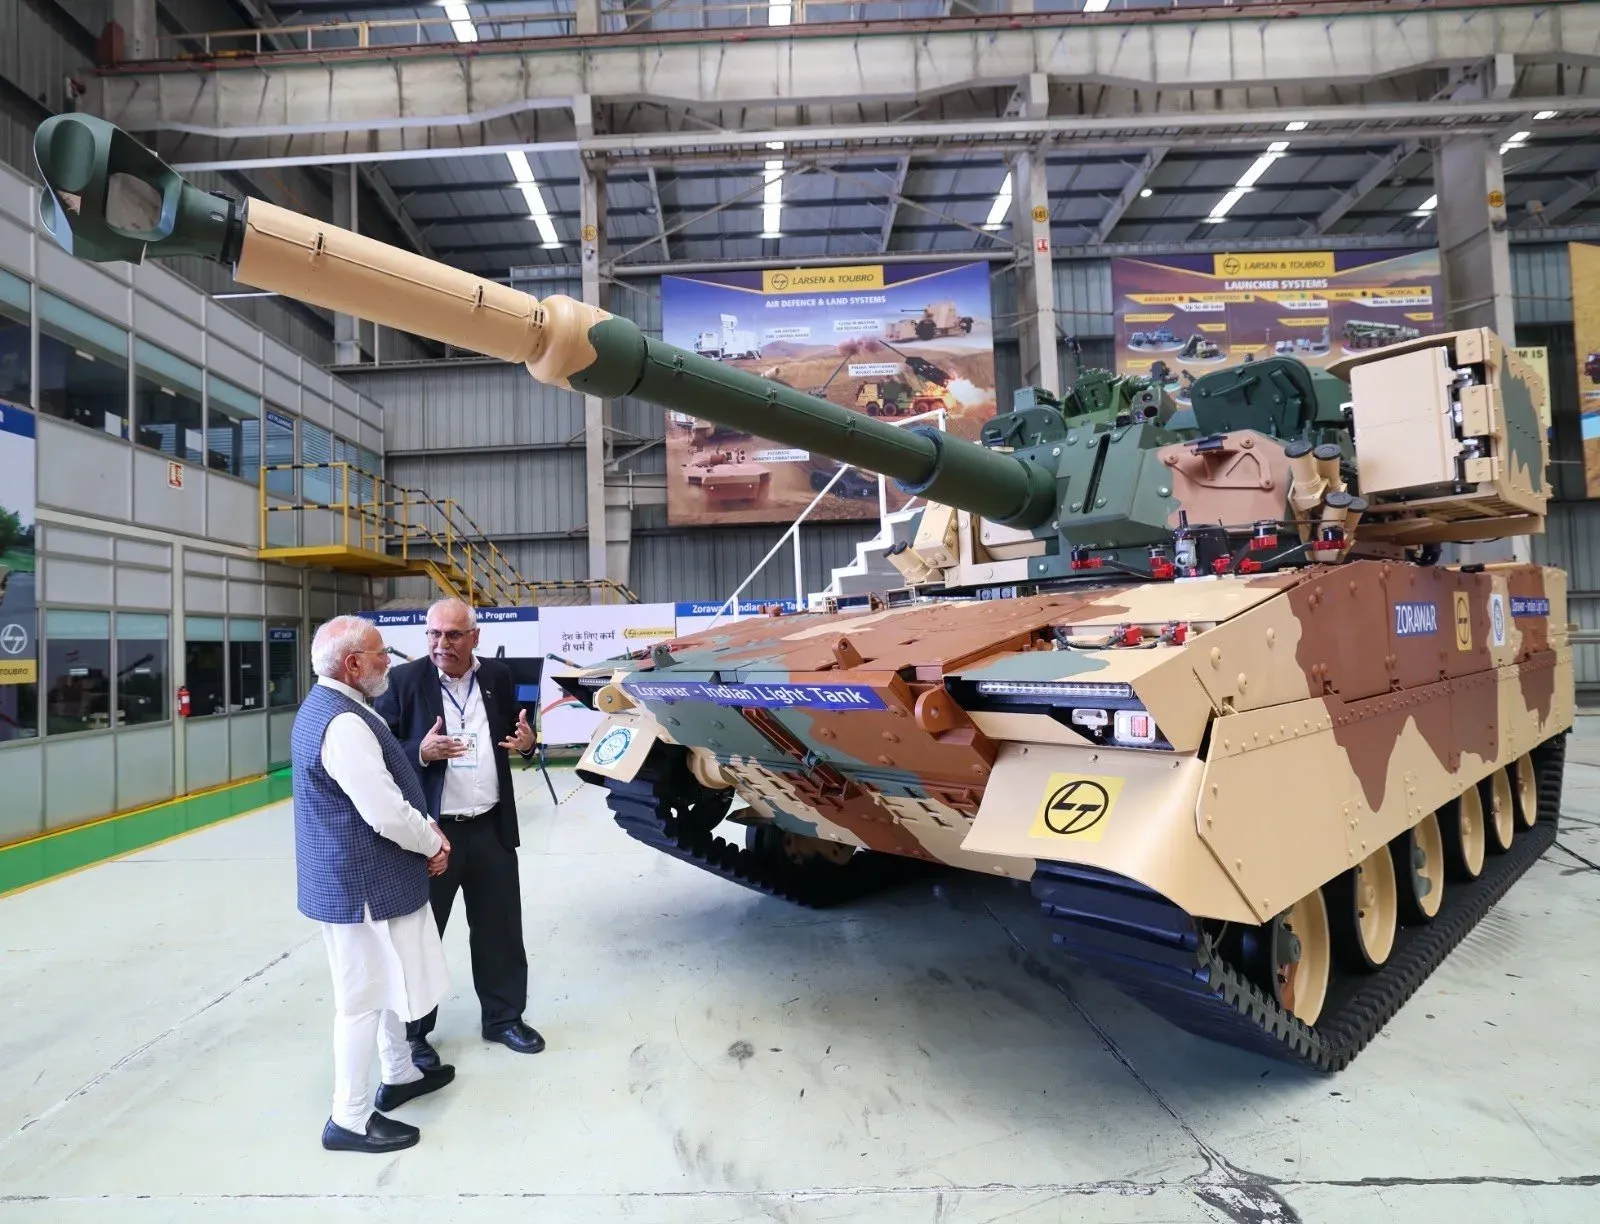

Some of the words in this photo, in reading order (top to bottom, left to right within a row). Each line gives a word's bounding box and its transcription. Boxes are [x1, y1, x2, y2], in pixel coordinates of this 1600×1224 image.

[792, 276, 826, 285] LARSEN
[838, 274, 874, 282] TOUBRO
[1225, 281, 1279, 290] LAUNCHER
[1281, 279, 1328, 289] SYSTEMS
[766, 300, 779, 308] AIR
[781, 299, 816, 307] DEFENCE
[818, 298, 824, 306] &
[826, 297, 848, 305] LAND
[850, 296, 886, 304] SYSTEMS
[1532, 350, 1544, 358] IS
[379, 615, 410, 623] Zorawar
[486, 612, 517, 621] Program
[1396, 606, 1437, 633] ZORAWAR
[562, 632, 573, 640] देश
[575, 631, 582, 640] के
[584, 631, 598, 640] लिए
[600, 630, 615, 640] कर्म
[562, 643, 570, 652] ही
[573, 642, 585, 651] धर्म
[588, 642, 593, 651] है
[631, 684, 688, 697] Zorawar
[701, 684, 754, 700] Indian
[754, 687, 809, 704] Light
[807, 688, 869, 704] Tank
